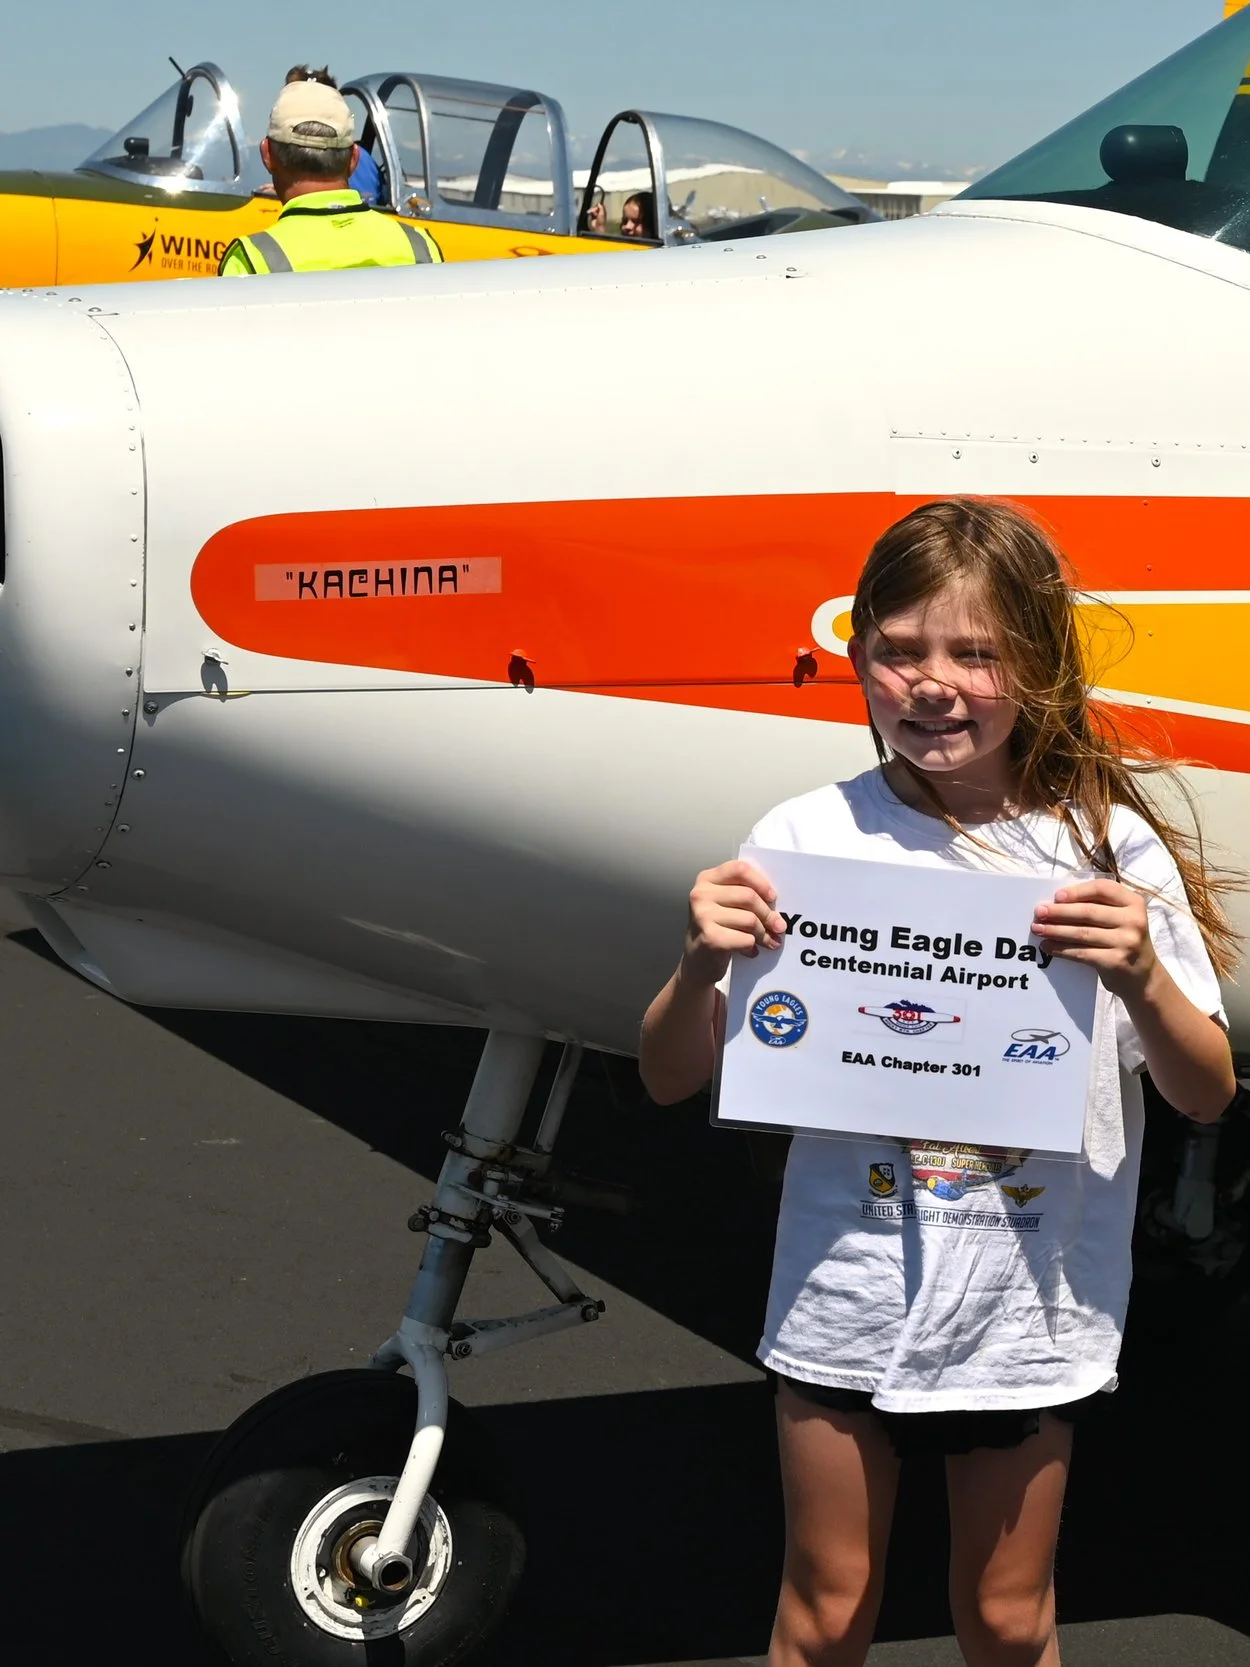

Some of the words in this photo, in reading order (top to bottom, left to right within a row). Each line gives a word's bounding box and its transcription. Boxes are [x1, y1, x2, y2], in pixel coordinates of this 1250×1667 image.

[161, 234, 226, 261] WING
[162, 258, 184, 270] OVER
[187, 261, 202, 272] THE
[779, 912, 879, 952] Young
[890, 926, 983, 960] Eagle
[800, 949, 932, 981] Centennial
[940, 966, 1029, 991] Airport
[755, 994, 780, 1011] YOUNG
[782, 995, 804, 1016] EAGLES
[1003, 1043, 1057, 1061] EAA
[842, 1051, 876, 1066] EAA
[881, 1055, 947, 1074] Chapter
[952, 1063, 981, 1077] 301
[951, 1157, 974, 1170] SUPER
[862, 1204, 893, 1217] UNITED
